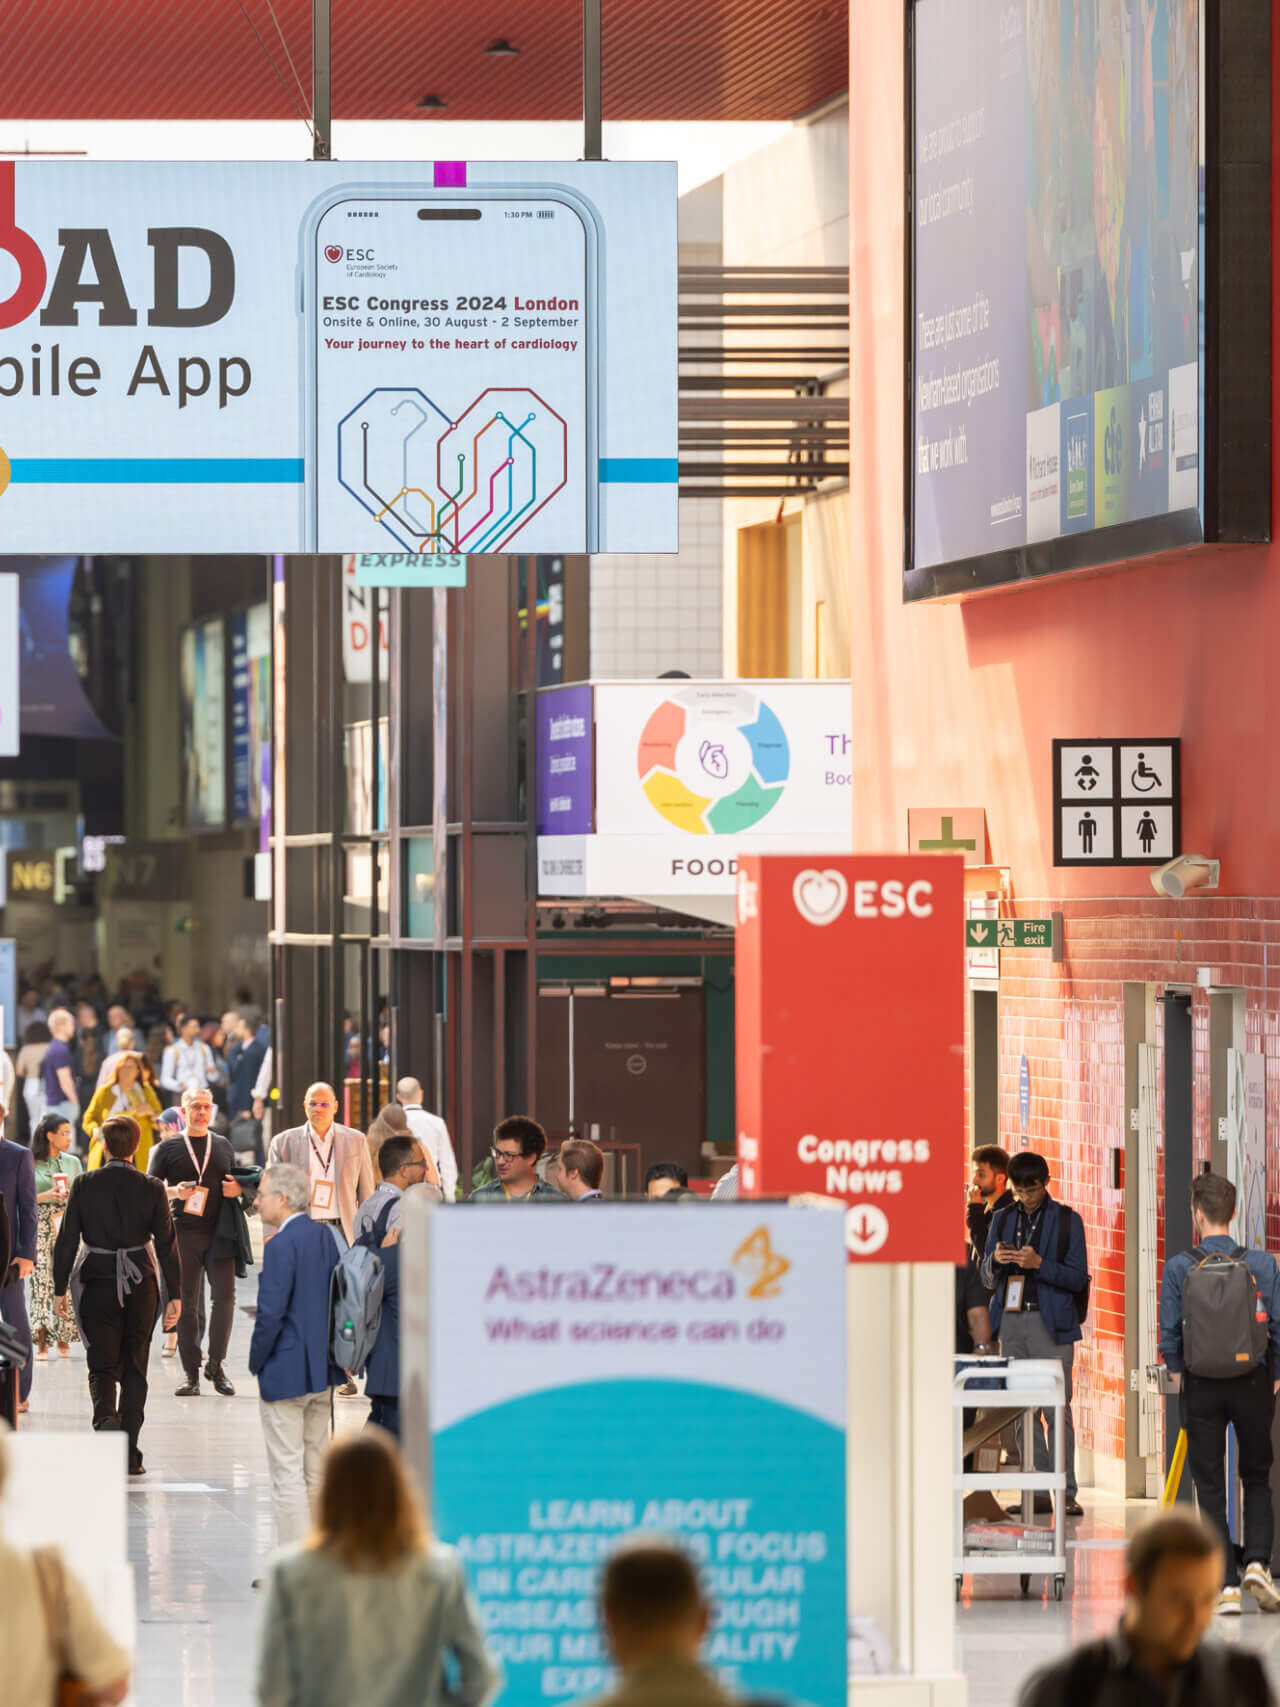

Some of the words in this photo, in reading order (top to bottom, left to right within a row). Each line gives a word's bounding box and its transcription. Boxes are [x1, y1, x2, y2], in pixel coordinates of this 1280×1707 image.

[346, 249, 375, 261] ESC
[323, 296, 359, 311] ESC
[367, 296, 448, 313] Congress
[455, 296, 507, 311] 2024
[514, 296, 579, 311] London
[323, 316, 362, 327] Onsite
[366, 316, 374, 327] &
[379, 316, 420, 328] Online,
[424, 317, 441, 327] 30
[445, 316, 488, 329] August
[501, 317, 509, 327] 2
[514, 316, 579, 329] September
[324, 338, 354, 349] Your
[358, 338, 407, 351] journey
[411, 339, 425, 349] to
[429, 338, 450, 349] the
[455, 338, 489, 349] heart
[494, 338, 506, 349] of
[511, 338, 578, 351] cardiology
[127, 344, 252, 408] App
[360, 555, 462, 567] EXPRESS
[12, 861, 53, 891] N6
[854, 880, 933, 918] ESC
[1023, 922, 1046, 933] Fire
[1023, 935, 1045, 945] exit
[797, 1134, 931, 1167] Congress
[826, 1165, 903, 1193] News
[484, 1263, 736, 1302] AstraZeneca
[483, 1316, 561, 1342] What
[569, 1316, 679, 1342] science
[686, 1318, 740, 1342] can
[745, 1314, 786, 1342] do
[528, 1499, 634, 1529] LEARN
[640, 1499, 752, 1528] ABOUT
[716, 1532, 827, 1562] FOCUS
[477, 1567, 511, 1594] IN
